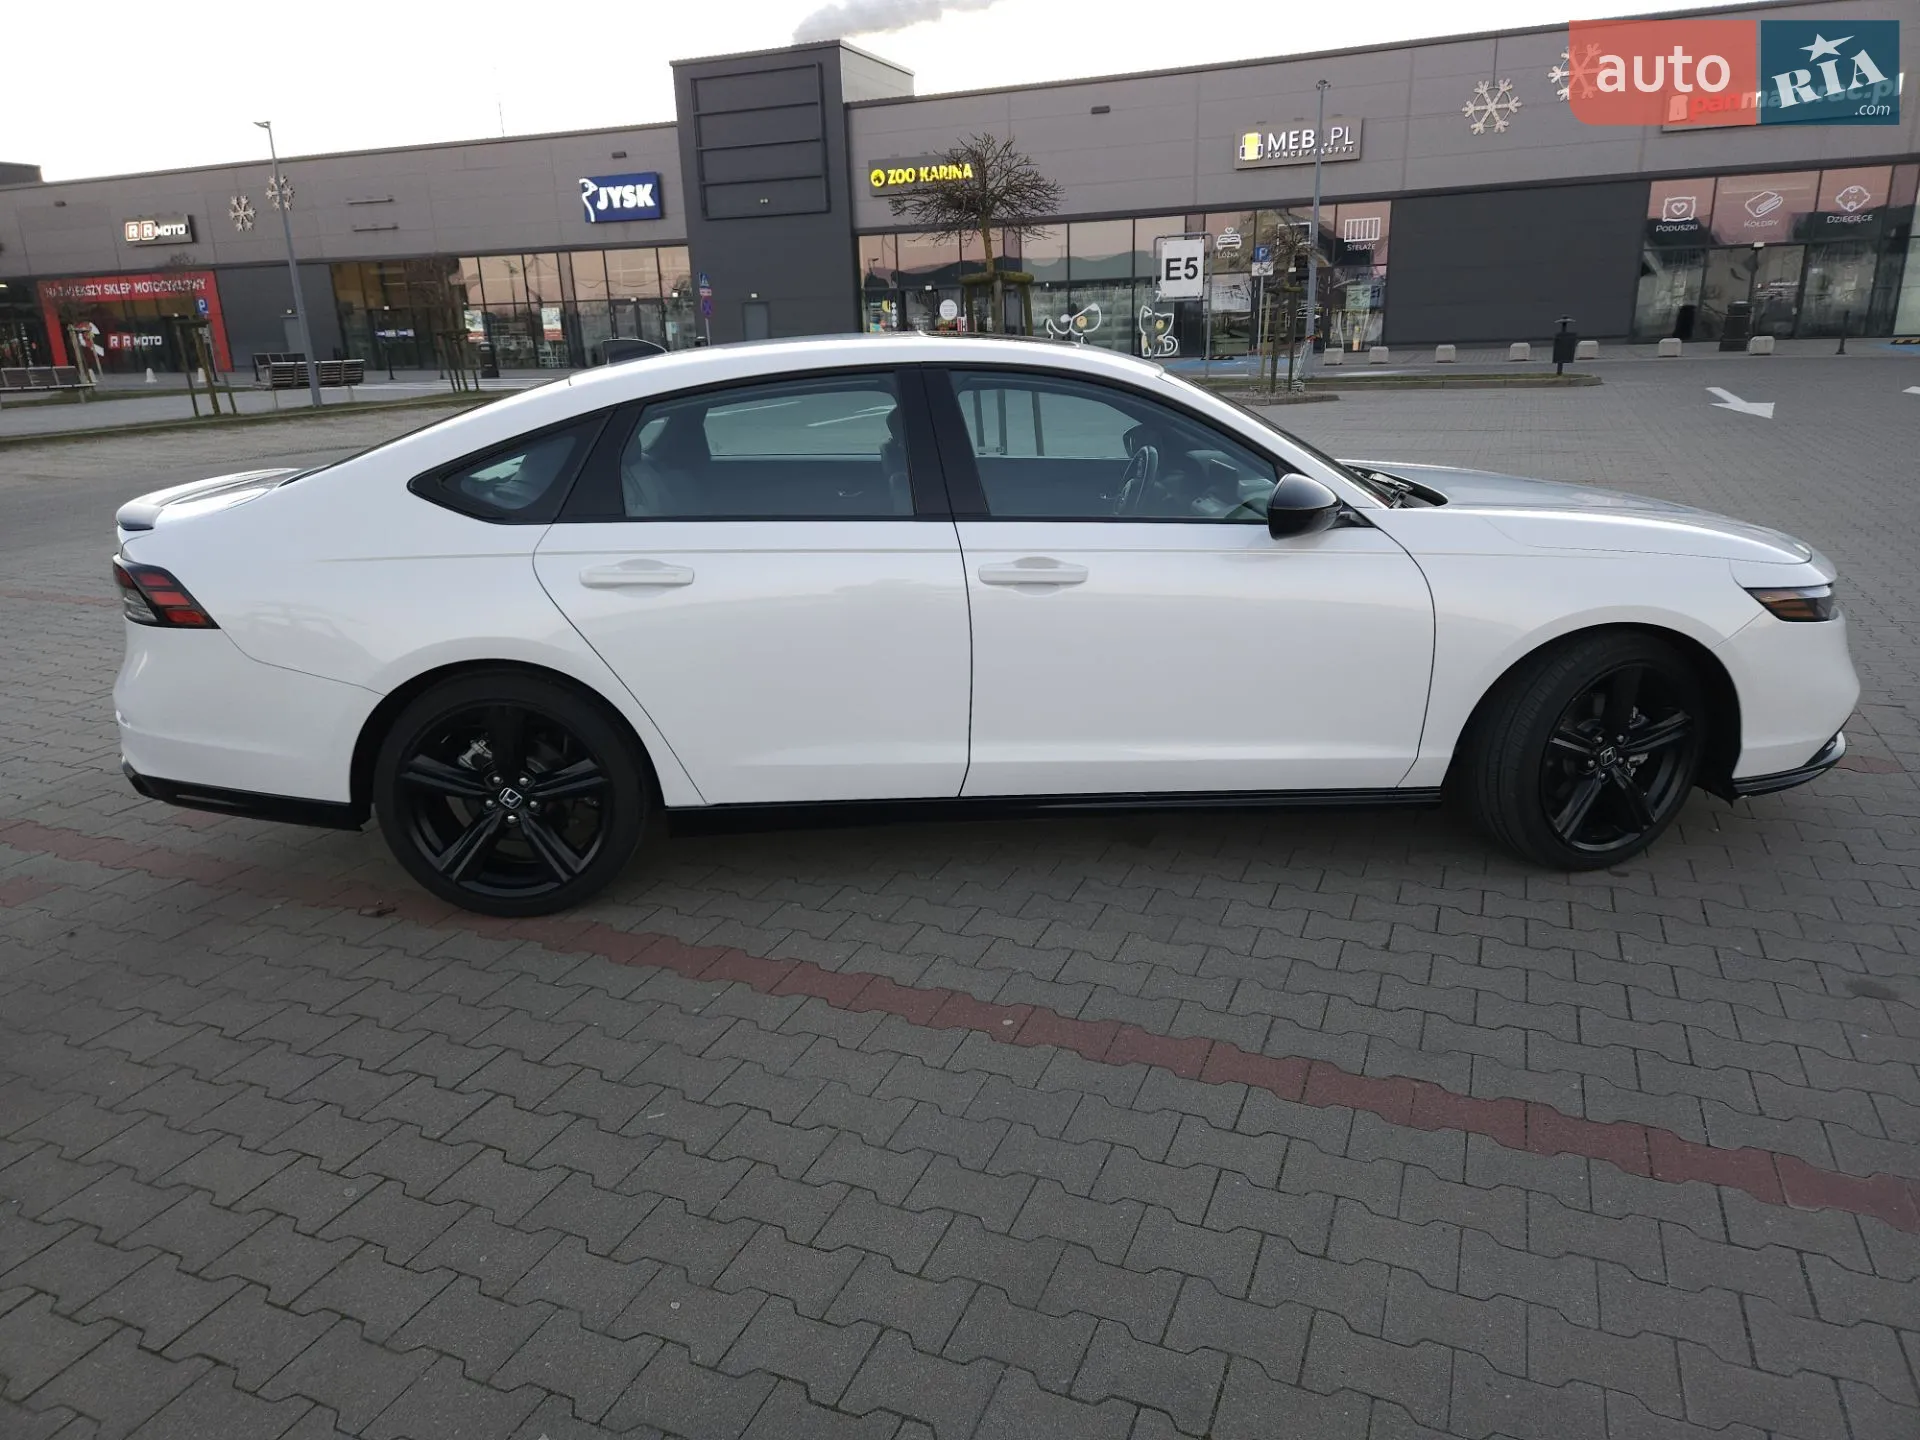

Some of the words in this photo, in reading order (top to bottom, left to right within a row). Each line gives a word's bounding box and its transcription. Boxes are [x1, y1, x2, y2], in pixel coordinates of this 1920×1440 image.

[1267, 126, 1355, 152] MEB.PL
[887, 167, 916, 185] ZOO
[919, 163, 973, 182] KARINA
[596, 183, 656, 210] JYSK
[154, 223, 186, 236] MOTO
[1165, 256, 1199, 281] E5
[104, 282, 132, 295] SKLEP
[133, 335, 163, 346] MOTO
